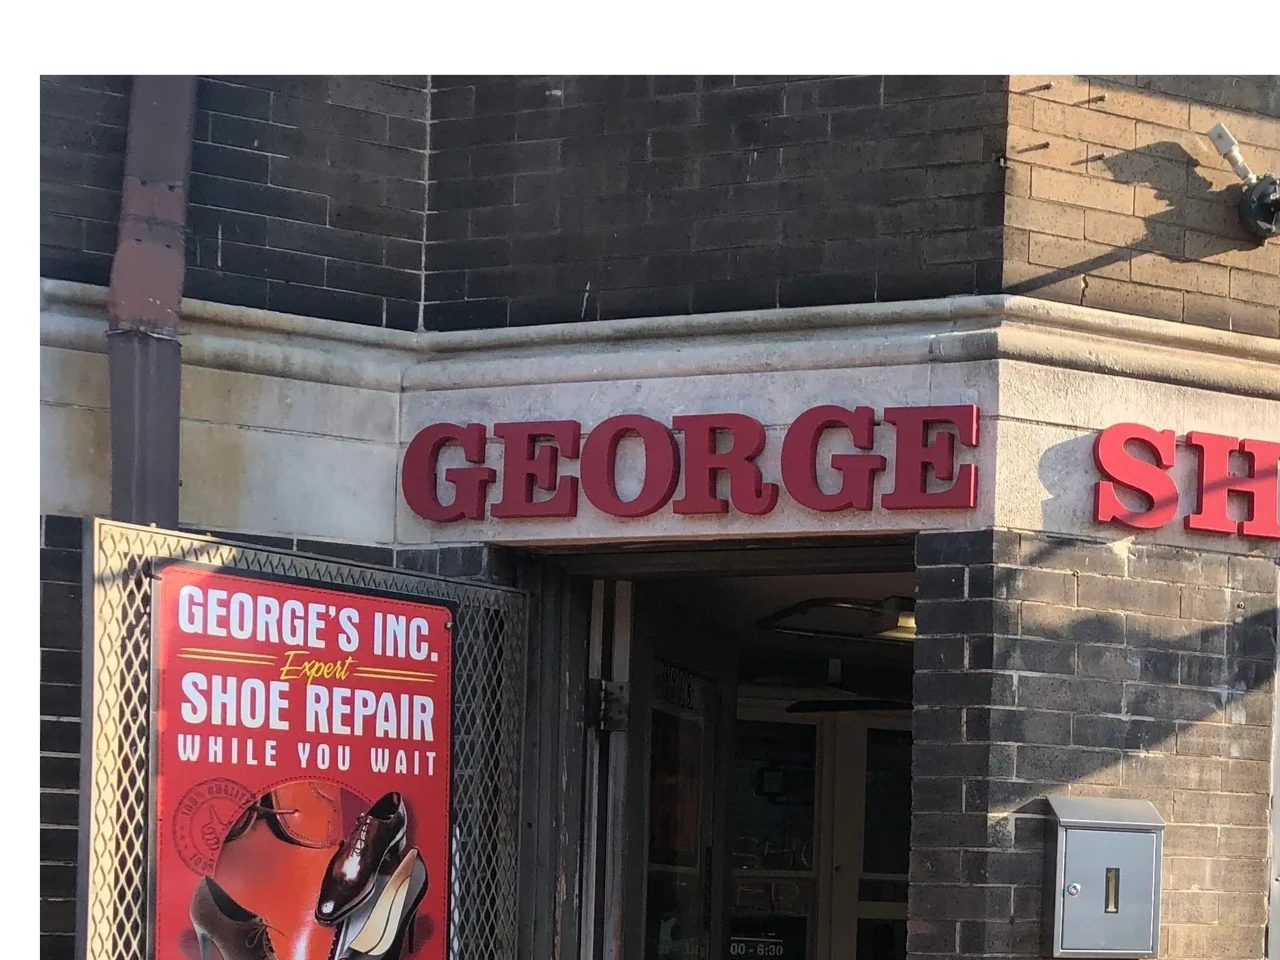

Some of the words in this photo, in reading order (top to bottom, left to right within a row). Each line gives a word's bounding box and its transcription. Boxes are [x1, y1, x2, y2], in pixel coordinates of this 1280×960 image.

[401, 404, 981, 523] GEORGE
[178, 585, 360, 653] GEORGE'S
[373, 611, 439, 662] INC.
[280, 650, 358, 686] Expert
[180, 672, 290, 731] SHOE
[306, 684, 435, 742] REPAIR
[177, 733, 277, 767] WHILE
[297, 742, 351, 771] YOU
[370, 747, 437, 777] WAIT
